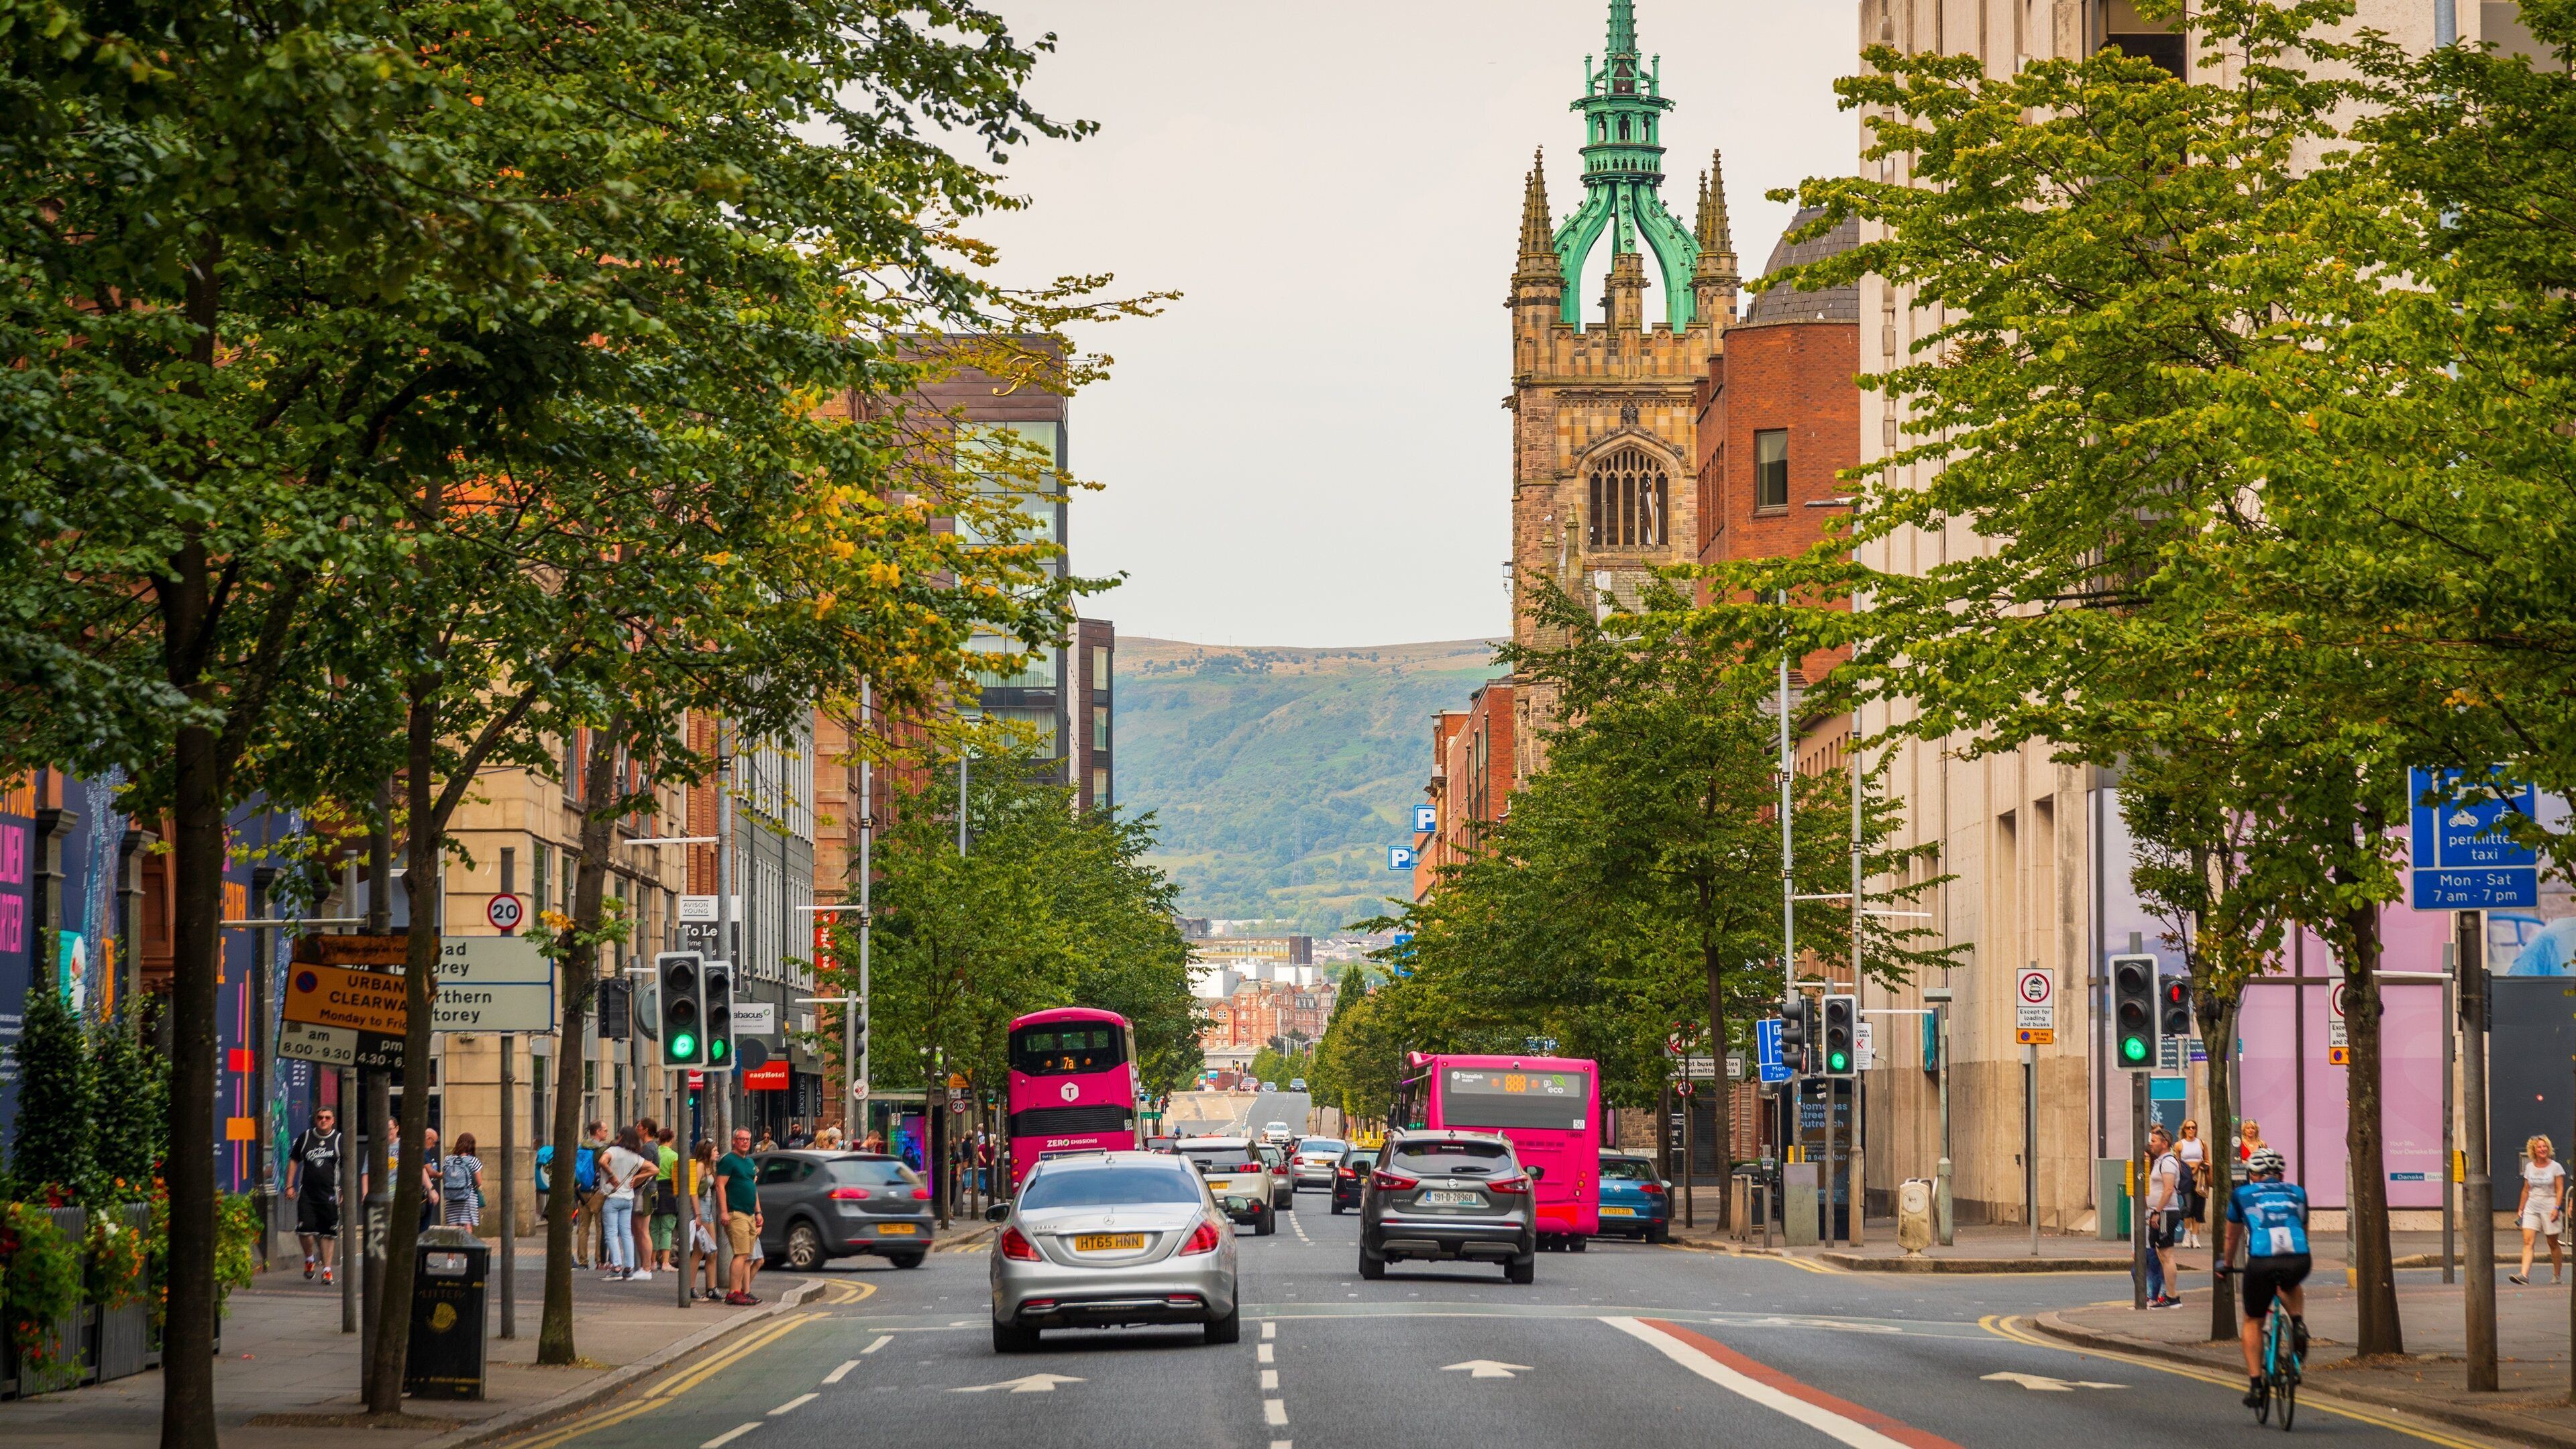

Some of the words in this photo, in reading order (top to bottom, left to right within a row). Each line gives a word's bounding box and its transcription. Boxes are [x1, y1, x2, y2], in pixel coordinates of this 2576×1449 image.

[1417, 809, 1435, 828] P
[1391, 849, 1409, 867] P
[2471, 849, 2498, 860] taxi
[2440, 874, 2471, 886] Mon
[2486, 873, 2512, 885] Sat
[2433, 890, 2442, 902] 7
[2447, 892, 2468, 902] am
[2482, 889, 2491, 901] 7
[2496, 892, 2518, 903] pm
[493, 904, 518, 919] 20
[682, 924, 699, 936] To
[347, 975, 407, 994] URBAN
[319, 1008, 366, 1026] Monday
[370, 1016, 382, 1026] to
[308, 1030, 330, 1042] am
[283, 1041, 313, 1056] 8.00
[322, 1047, 352, 1061] 9.30
[380, 1040, 403, 1053] pm
[357, 1052, 386, 1065] 4.30
[1063, 1057, 1074, 1070] 7a
[1505, 1074, 1527, 1092] 888
[1543, 1079, 1552, 1087] go
[1065, 1087, 1074, 1097] T
[1548, 1086, 1564, 1094] eco
[953, 1102, 964, 1110] 20
[1574, 1120, 1583, 1128] 50
[1046, 1138, 1070, 1148] ZERO
[1433, 1193, 1473, 1202] 191-D-28960
[1080, 1235, 1112, 1250] HT65
[1116, 1234, 1140, 1248] HNN
